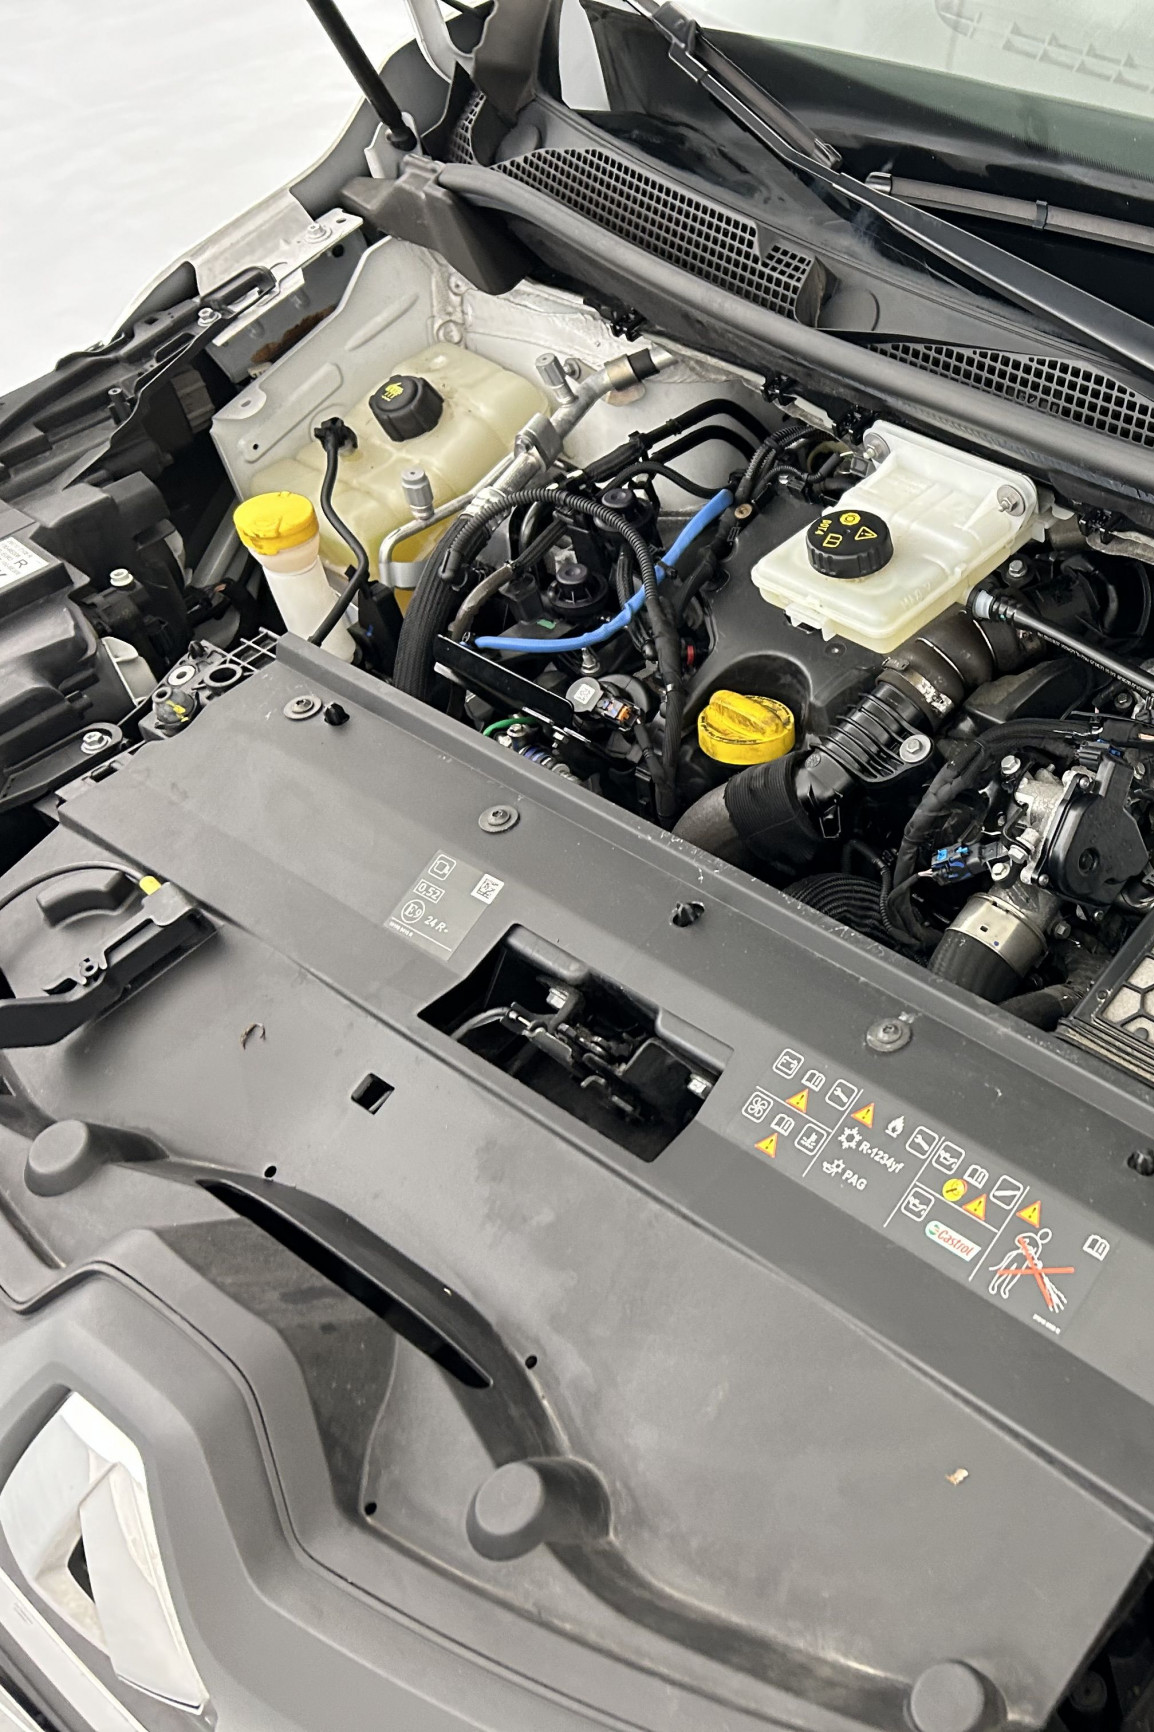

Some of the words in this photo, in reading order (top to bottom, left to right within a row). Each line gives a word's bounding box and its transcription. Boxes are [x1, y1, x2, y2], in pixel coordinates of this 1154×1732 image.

[418, 883, 441, 900] 0,52
[424, 915, 438, 927] 24
[858, 1141, 905, 1175] R-1234yf
[842, 1168, 868, 1190] PAG
[937, 1228, 974, 1257] Castrol
